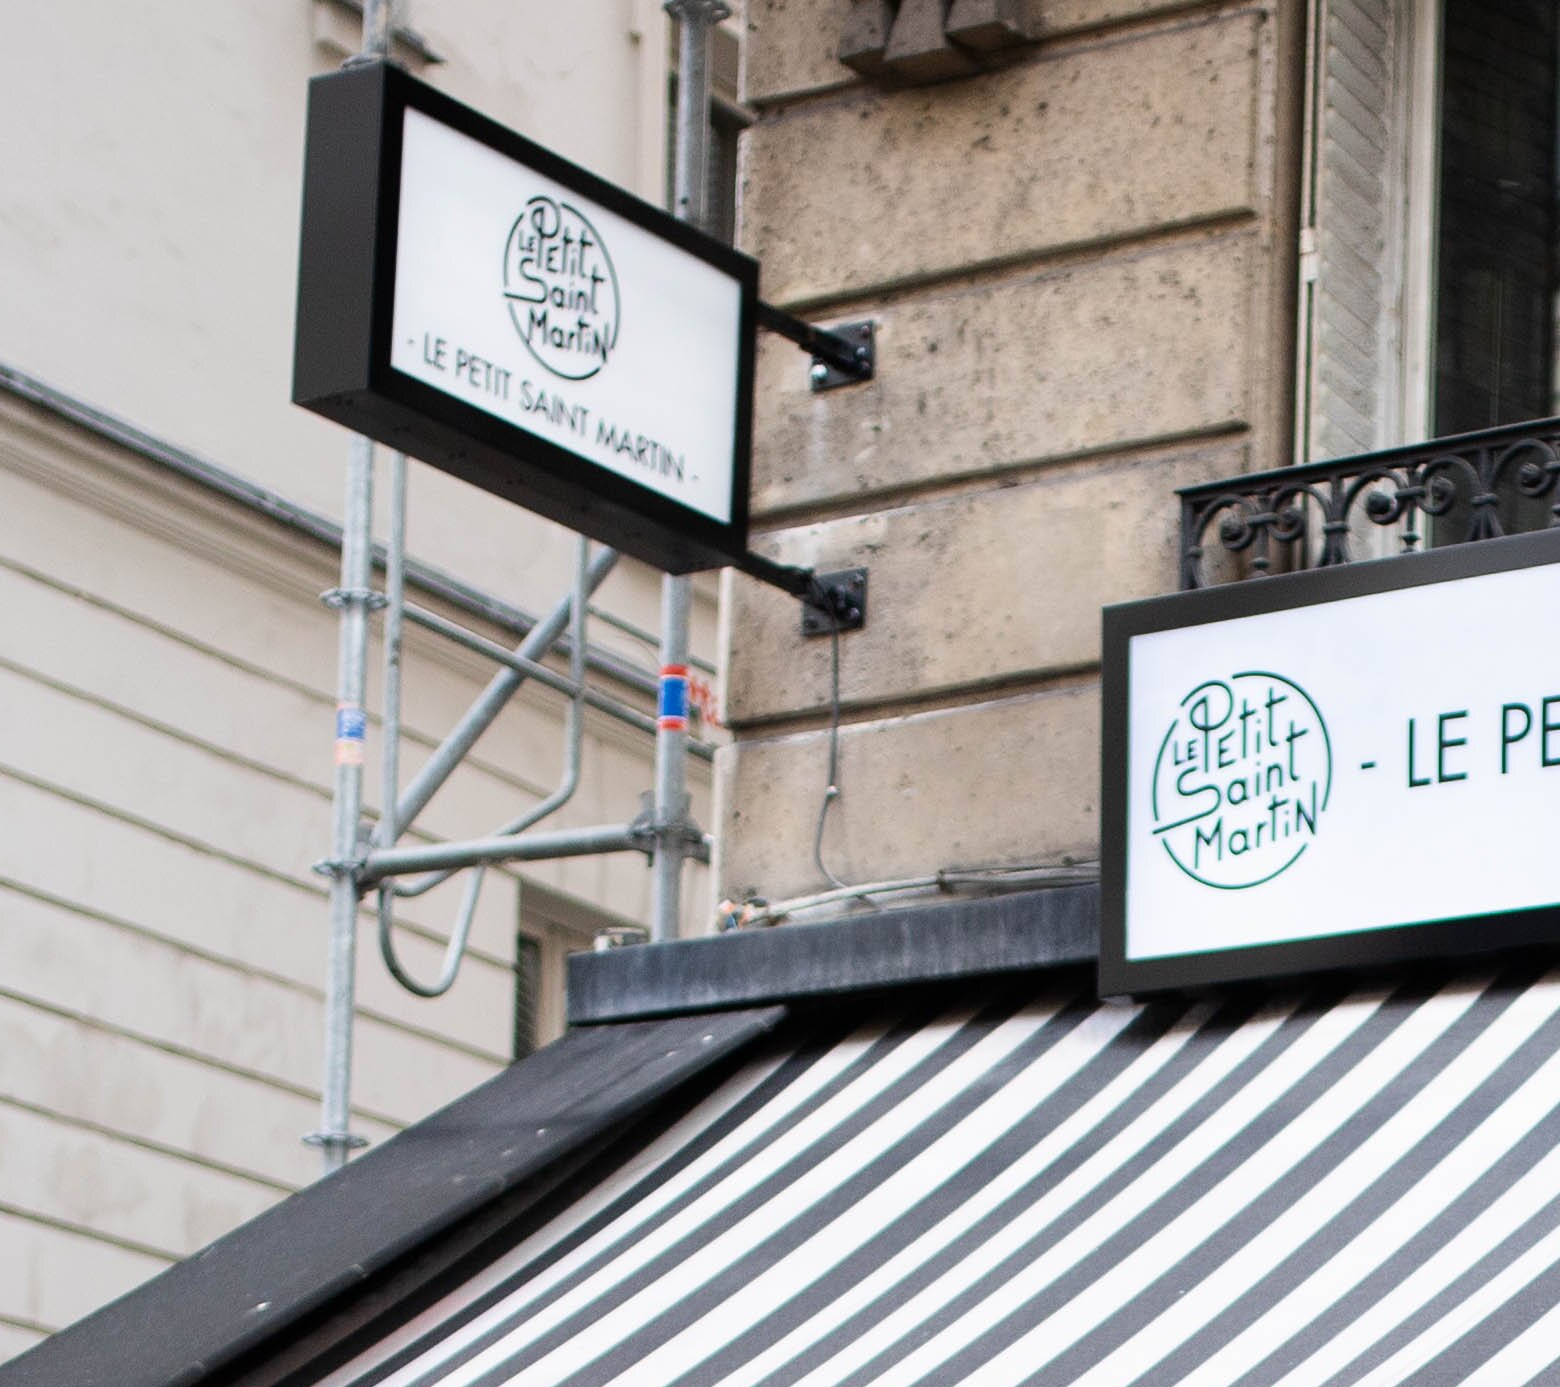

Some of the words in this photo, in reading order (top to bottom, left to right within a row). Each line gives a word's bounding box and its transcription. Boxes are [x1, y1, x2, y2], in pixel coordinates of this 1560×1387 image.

[423, 331, 446, 371] LE
[455, 347, 511, 400] PETIT
[520, 380, 590, 436] SAINT
[596, 416, 685, 482] MARTIN
[1406, 709, 1470, 789] LE
